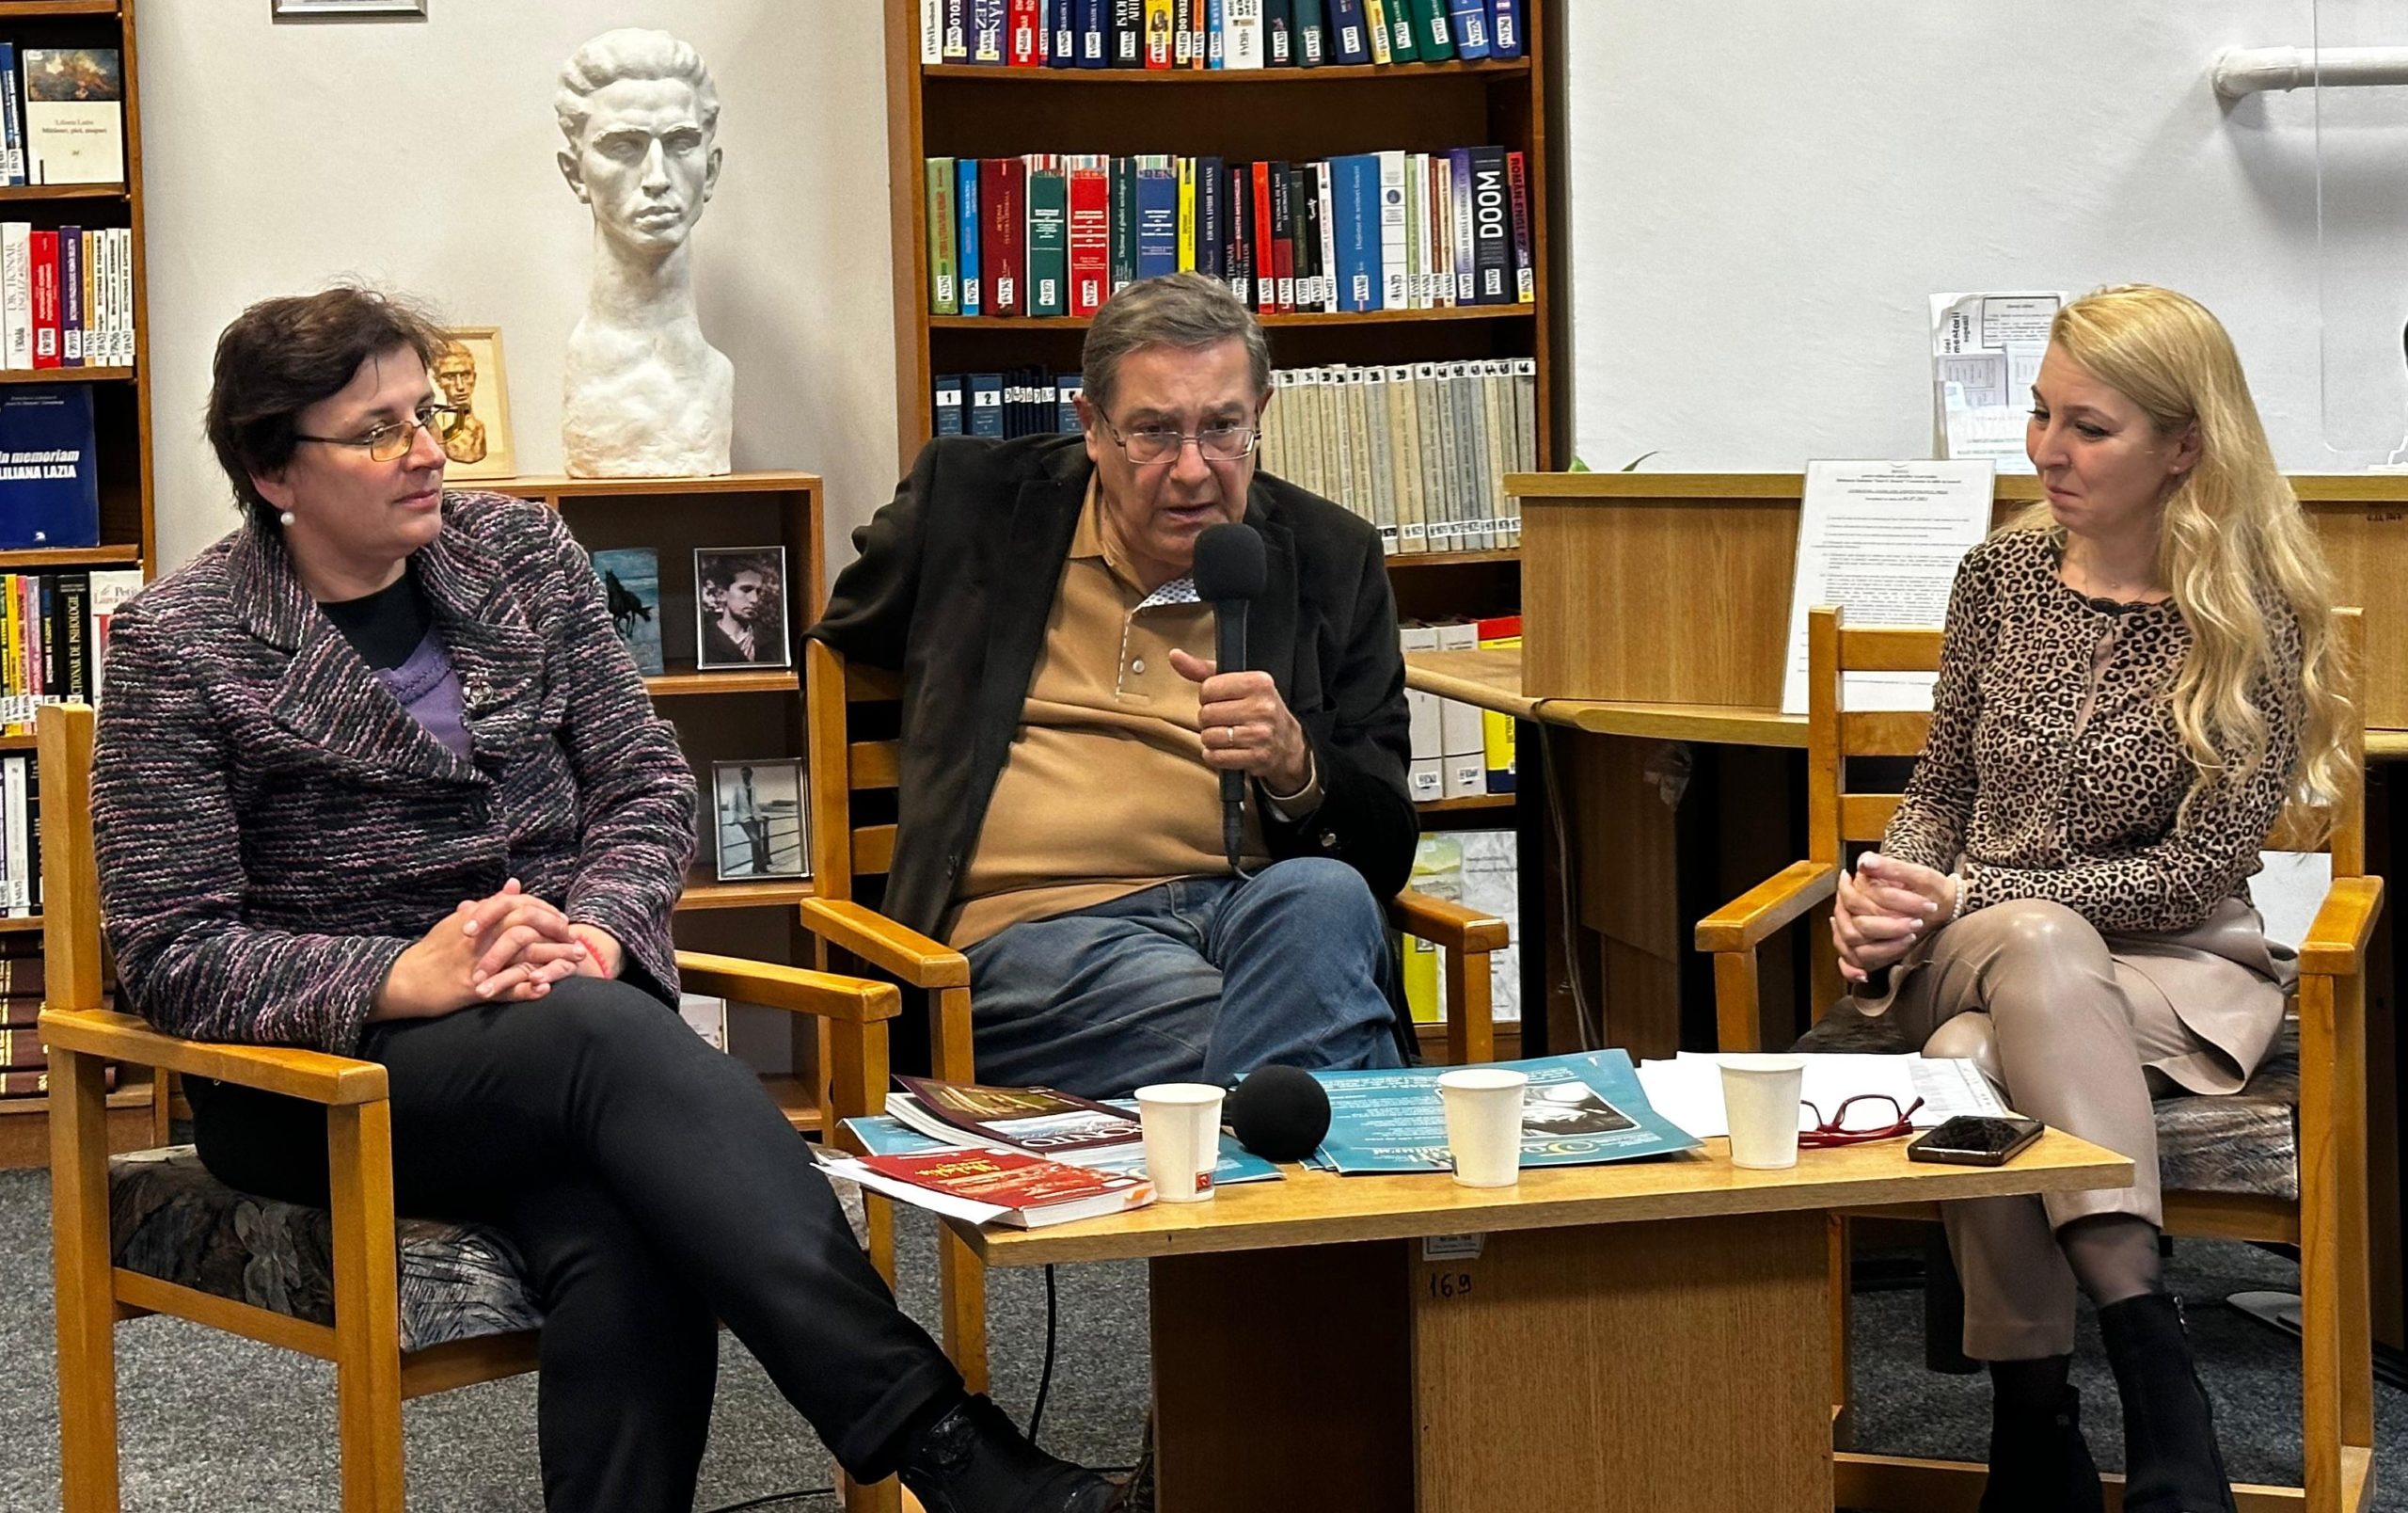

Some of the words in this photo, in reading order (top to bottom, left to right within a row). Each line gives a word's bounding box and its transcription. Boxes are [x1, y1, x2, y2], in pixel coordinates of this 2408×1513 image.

[1477, 170, 1503, 239] DOOM
[11, 450, 80, 463] memoriam
[43, 465, 77, 478] LAZIA
[68, 595, 81, 644] PSIHOLOGIE
[70, 644, 81, 657] DE
[70, 657, 83, 694] CTIONAR
[1430, 1273, 1472, 1298] 169
